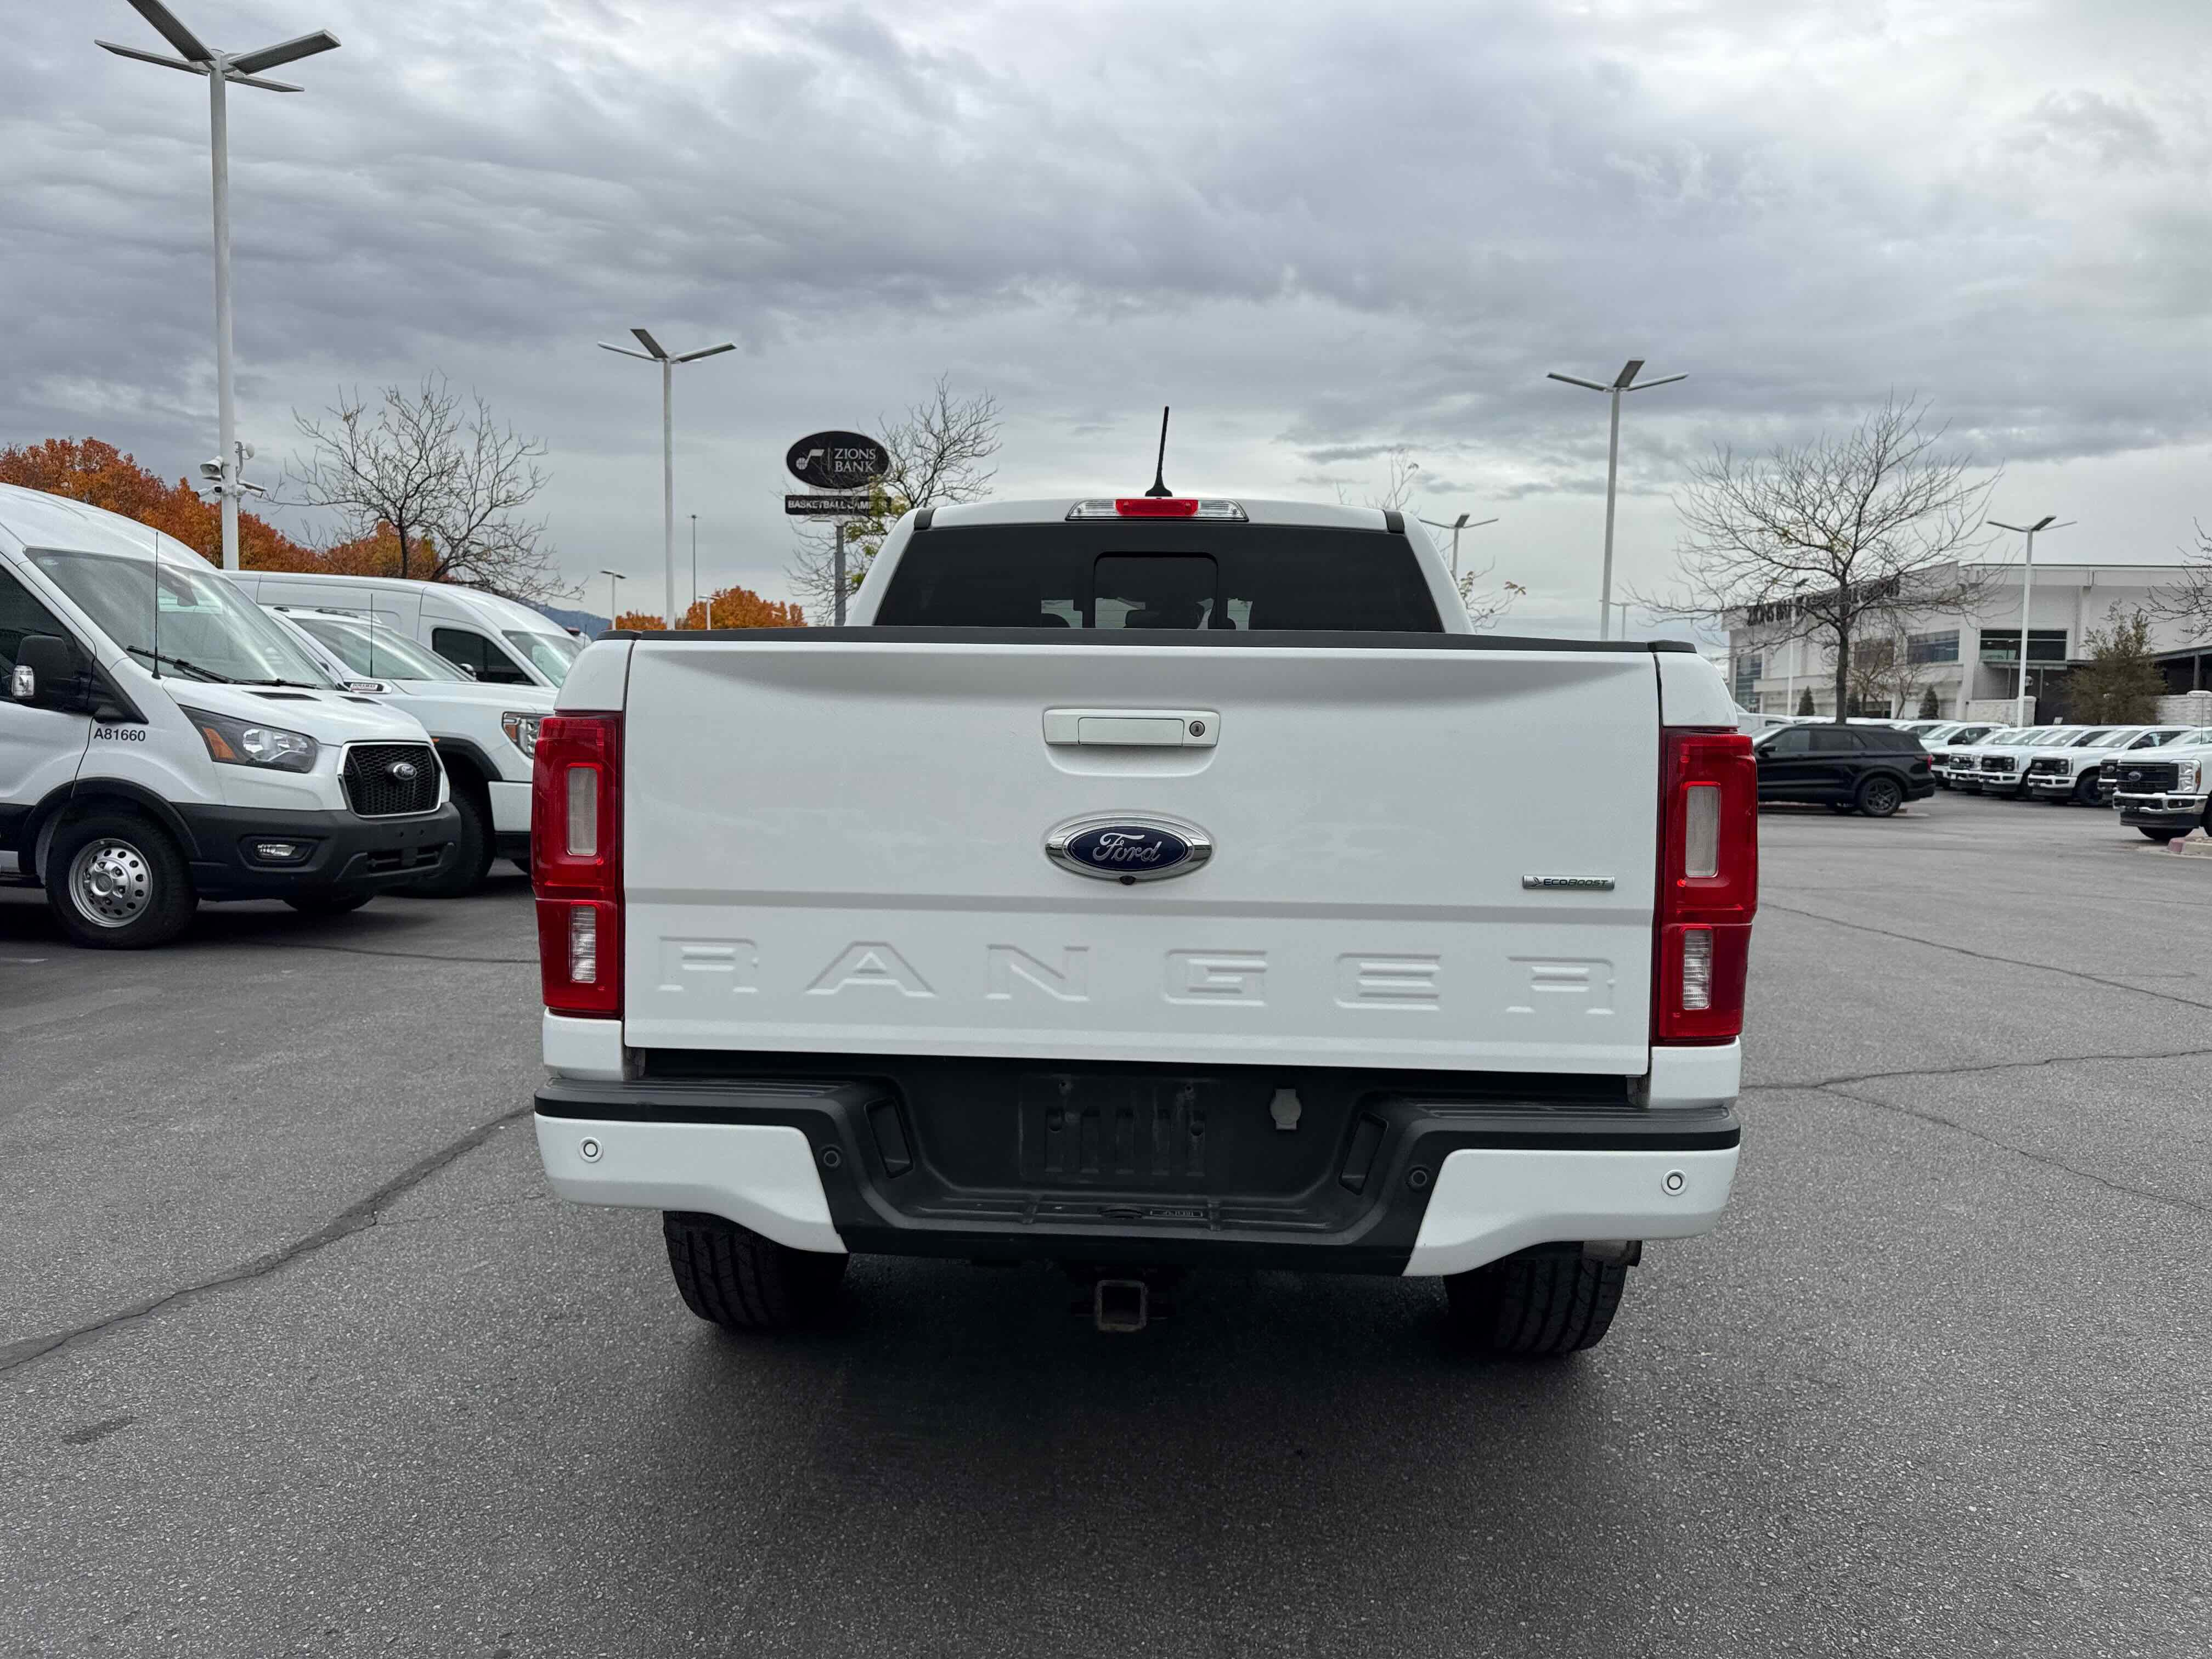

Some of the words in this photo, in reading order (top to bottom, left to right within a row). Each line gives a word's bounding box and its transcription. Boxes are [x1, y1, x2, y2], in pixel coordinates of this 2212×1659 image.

[834, 448, 876, 460] ZIONS
[834, 461, 874, 473] BANK
[788, 499, 847, 509] BASKETBALL
[93, 727, 146, 742] A81660
[1092, 832, 1163, 862] Ford
[658, 936, 1615, 1014] RANGER
